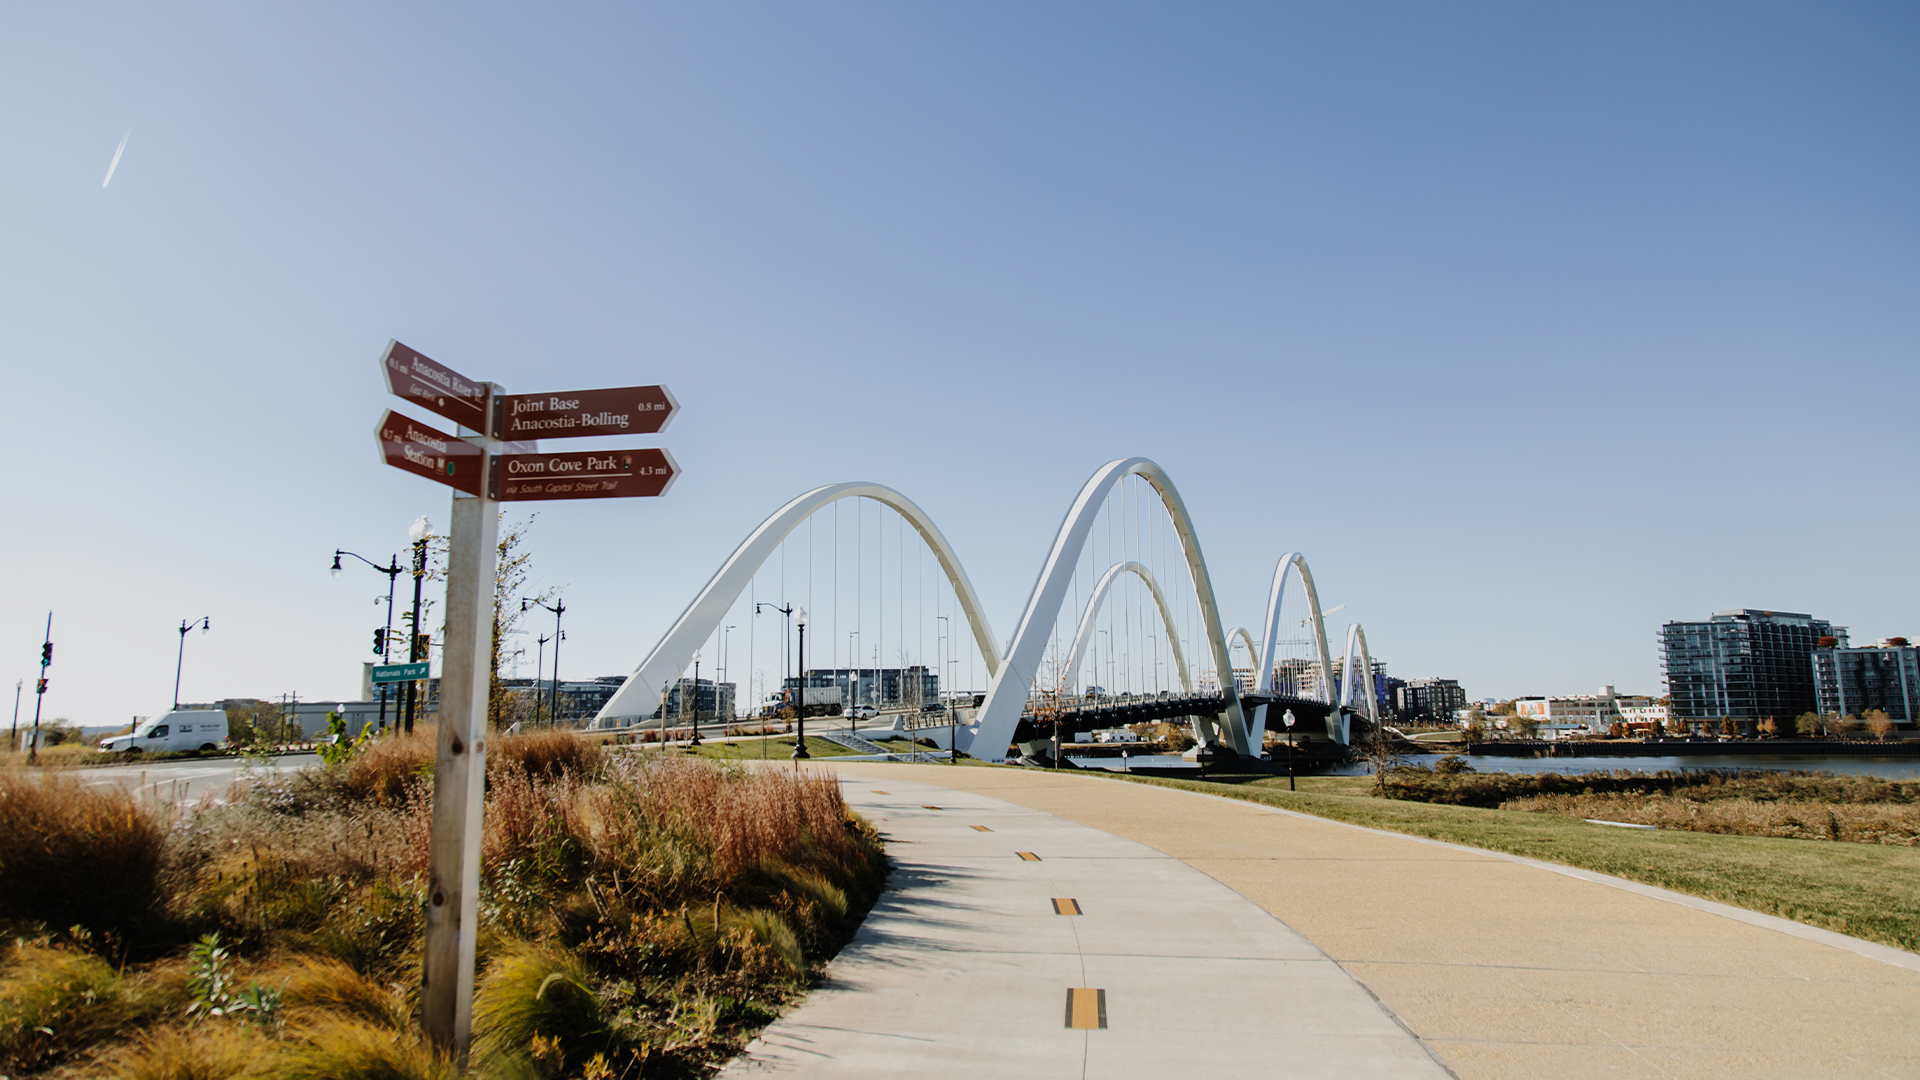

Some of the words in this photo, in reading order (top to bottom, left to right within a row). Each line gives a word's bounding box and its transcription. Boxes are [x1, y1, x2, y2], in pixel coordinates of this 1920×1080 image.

[400, 364, 408, 375] mi
[411, 356, 451, 388] Anacostia
[452, 376, 472, 397] River
[511, 400, 545, 416] Joint
[549, 397, 580, 411] Base
[638, 402, 652, 411] 0.8
[653, 401, 665, 411] mi
[510, 412, 629, 431] Anacostia-Bolling
[382, 428, 394, 440] 0.7
[393, 434, 402, 444] mi
[405, 424, 447, 453] Anacostia
[403, 444, 435, 469] Station
[508, 459, 544, 474] Oxon
[548, 458, 582, 472] Cove
[587, 456, 617, 470] Park
[639, 466, 653, 476] 4.3
[654, 465, 667, 476] mi
[506, 484, 518, 494] via
[519, 484, 543, 494] South
[545, 482, 574, 494] Capitol
[574, 482, 599, 492] Street
[601, 480, 618, 491] Trail
[375, 670, 401, 678] Nationals
[403, 668, 416, 676] Park
